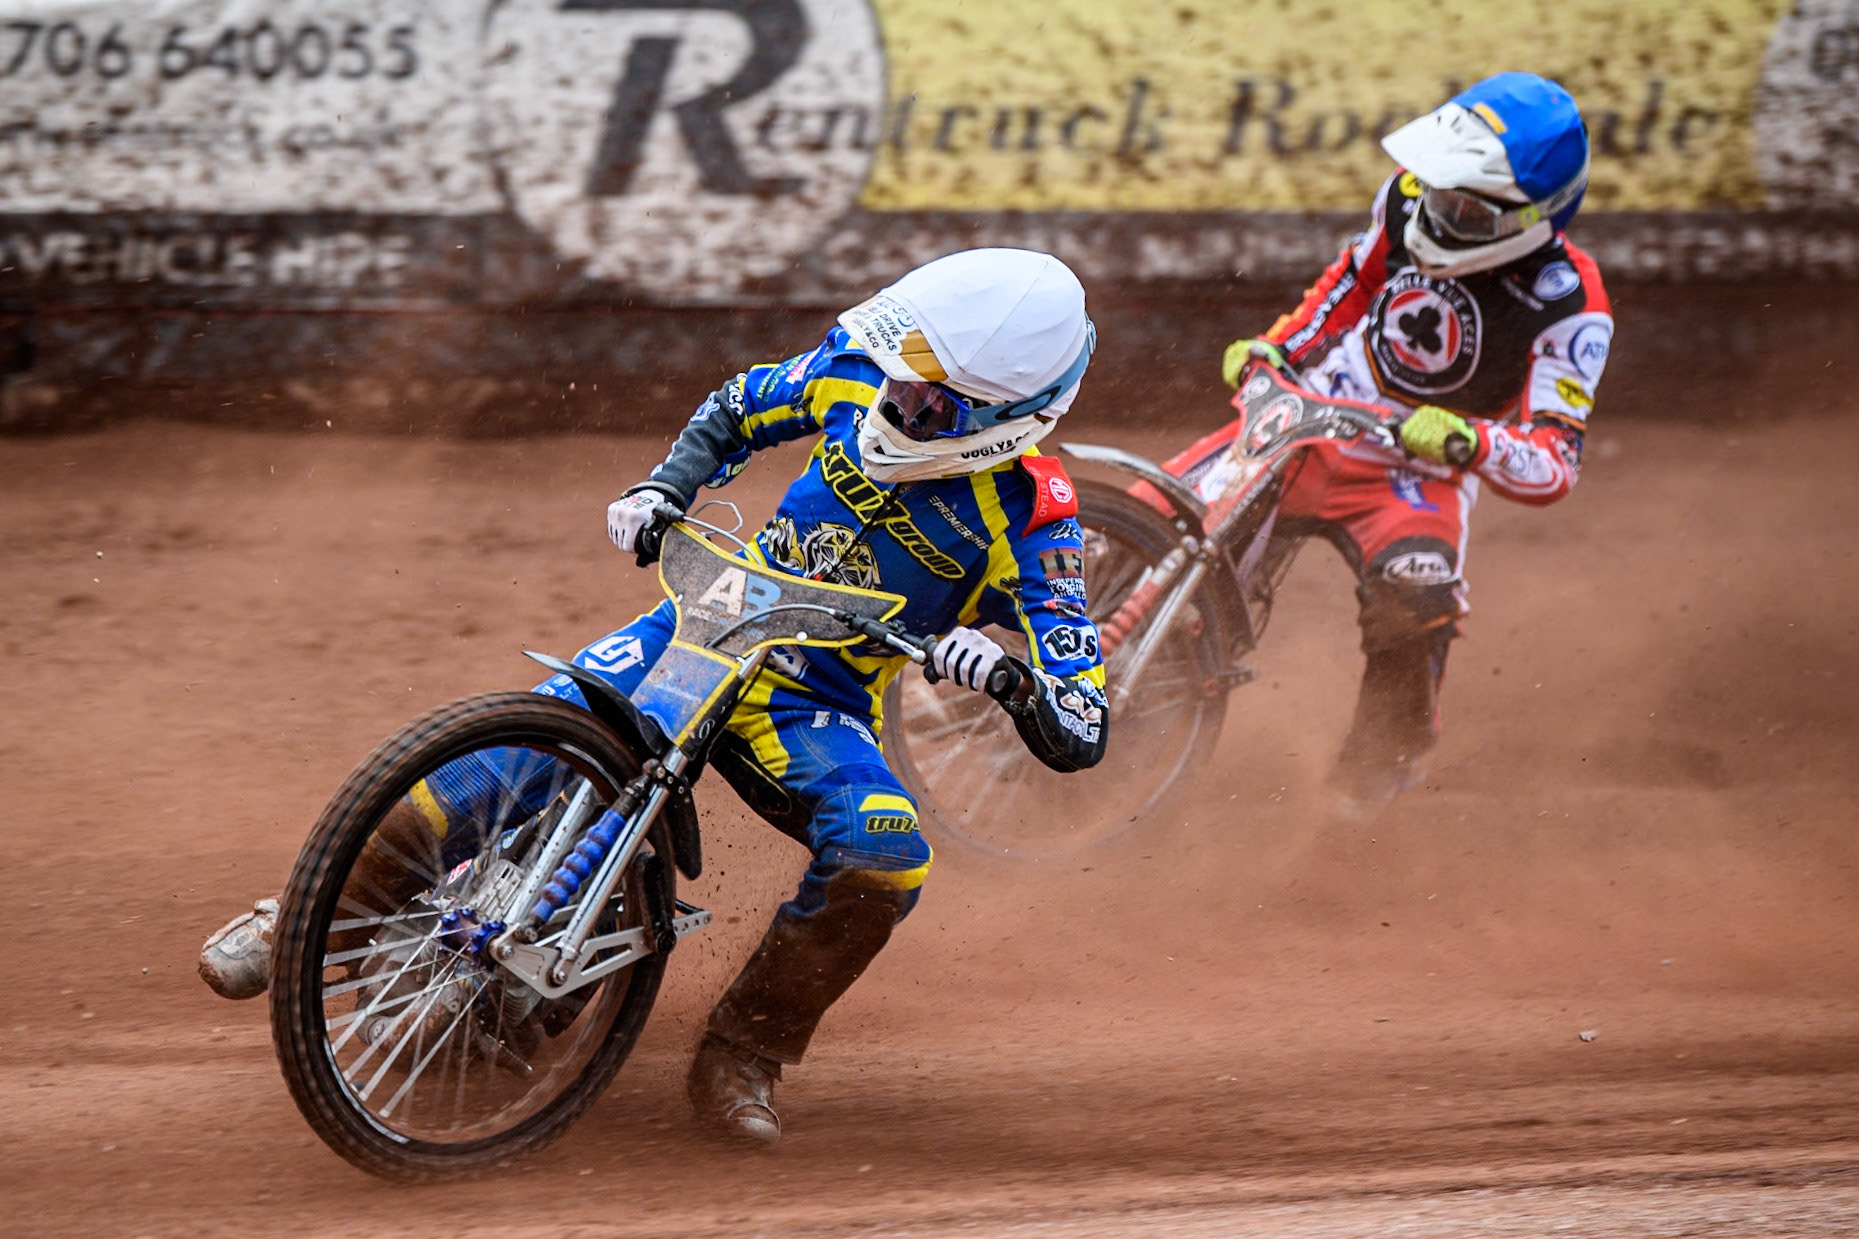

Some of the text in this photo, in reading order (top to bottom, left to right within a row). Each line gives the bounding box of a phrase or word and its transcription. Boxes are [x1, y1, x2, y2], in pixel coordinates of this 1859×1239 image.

[0, 21, 420, 80] 706 640055
[871, 318, 898, 352] TRUCKS
[879, 313, 902, 338] DRIVE
[1460, 312, 1476, 357] ACES
